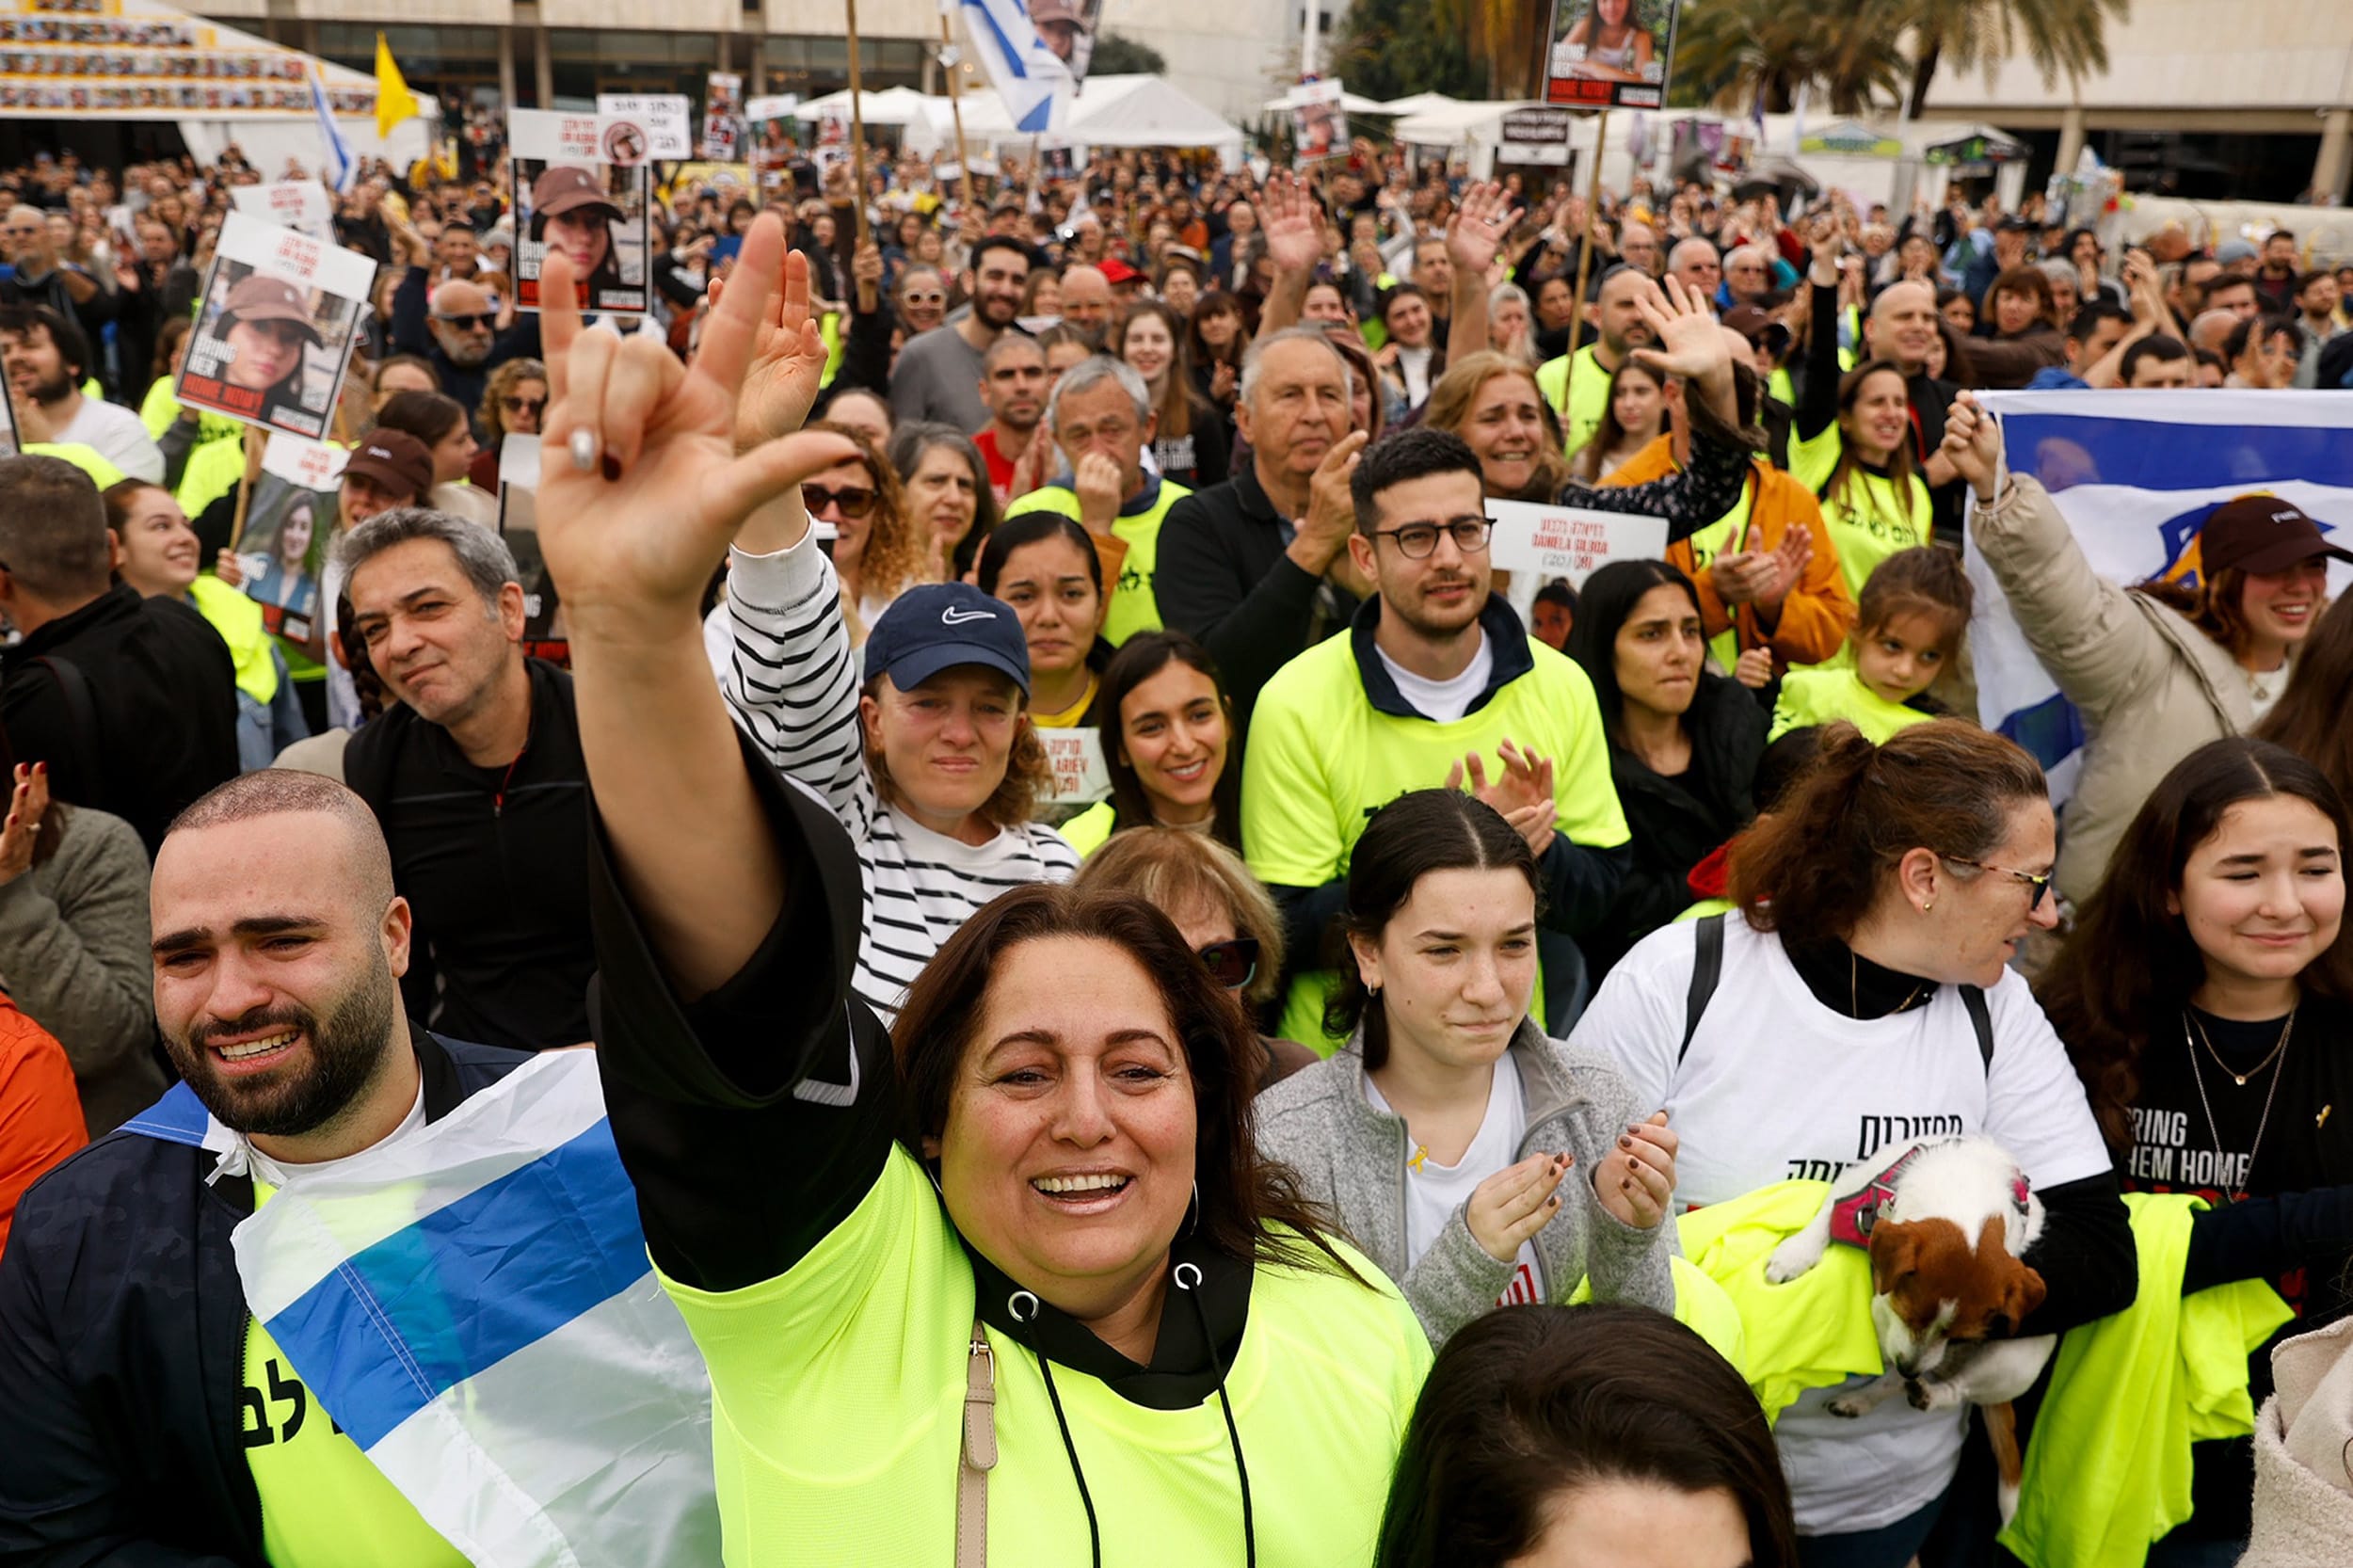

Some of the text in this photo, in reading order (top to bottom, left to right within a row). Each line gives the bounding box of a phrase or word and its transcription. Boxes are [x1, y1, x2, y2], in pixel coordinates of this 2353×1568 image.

[1531, 534, 1571, 551] DANIELA
[2127, 1108, 2188, 1146] RING
[2181, 1150, 2250, 1187] HOME
